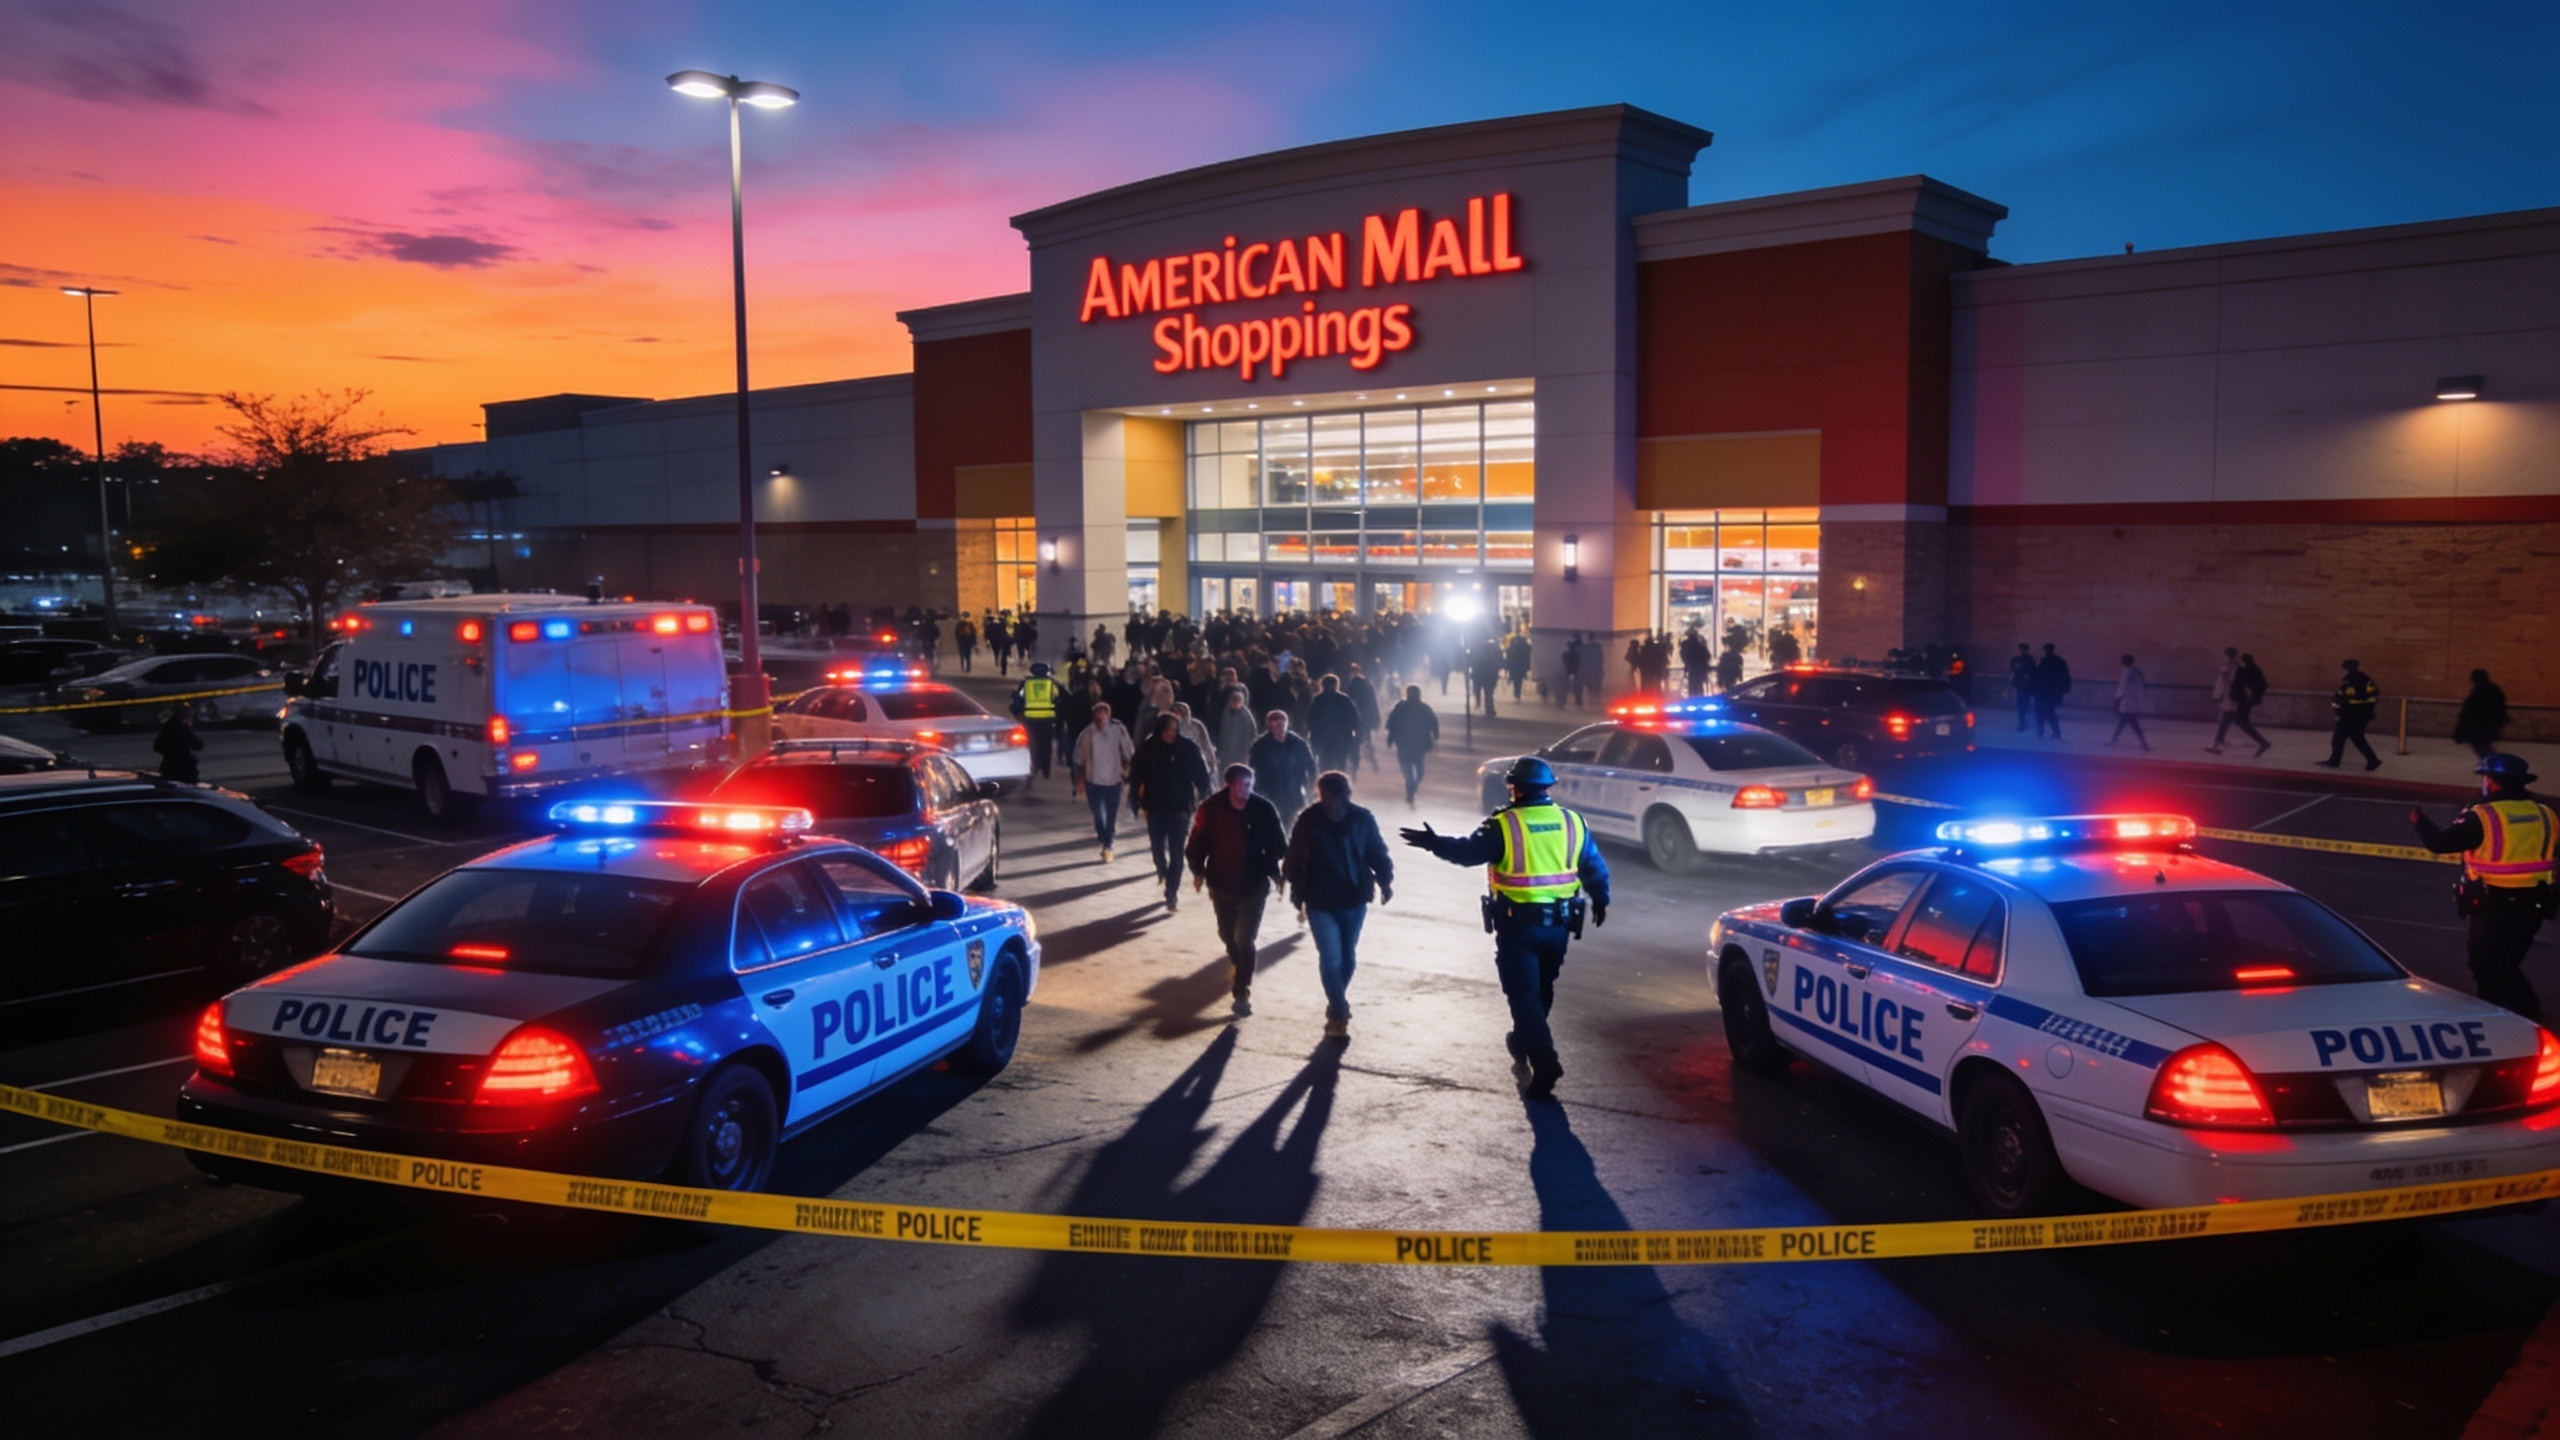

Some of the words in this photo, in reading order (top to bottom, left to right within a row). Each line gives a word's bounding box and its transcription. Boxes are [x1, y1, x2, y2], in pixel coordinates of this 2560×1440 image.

[1153, 301, 1413, 381] Shoppings
[354, 660, 437, 703] POLICE
[273, 1000, 438, 1047] POLICE
[812, 956, 954, 1058] POLICE
[1793, 965, 1924, 1061] POLICE
[2310, 1021, 2492, 1066] POLICE
[412, 1162, 482, 1191] POLICE
[897, 1212, 982, 1242] POLICE
[1780, 1231, 1875, 1257] POLICE
[1396, 1236, 1493, 1263] POLICE
